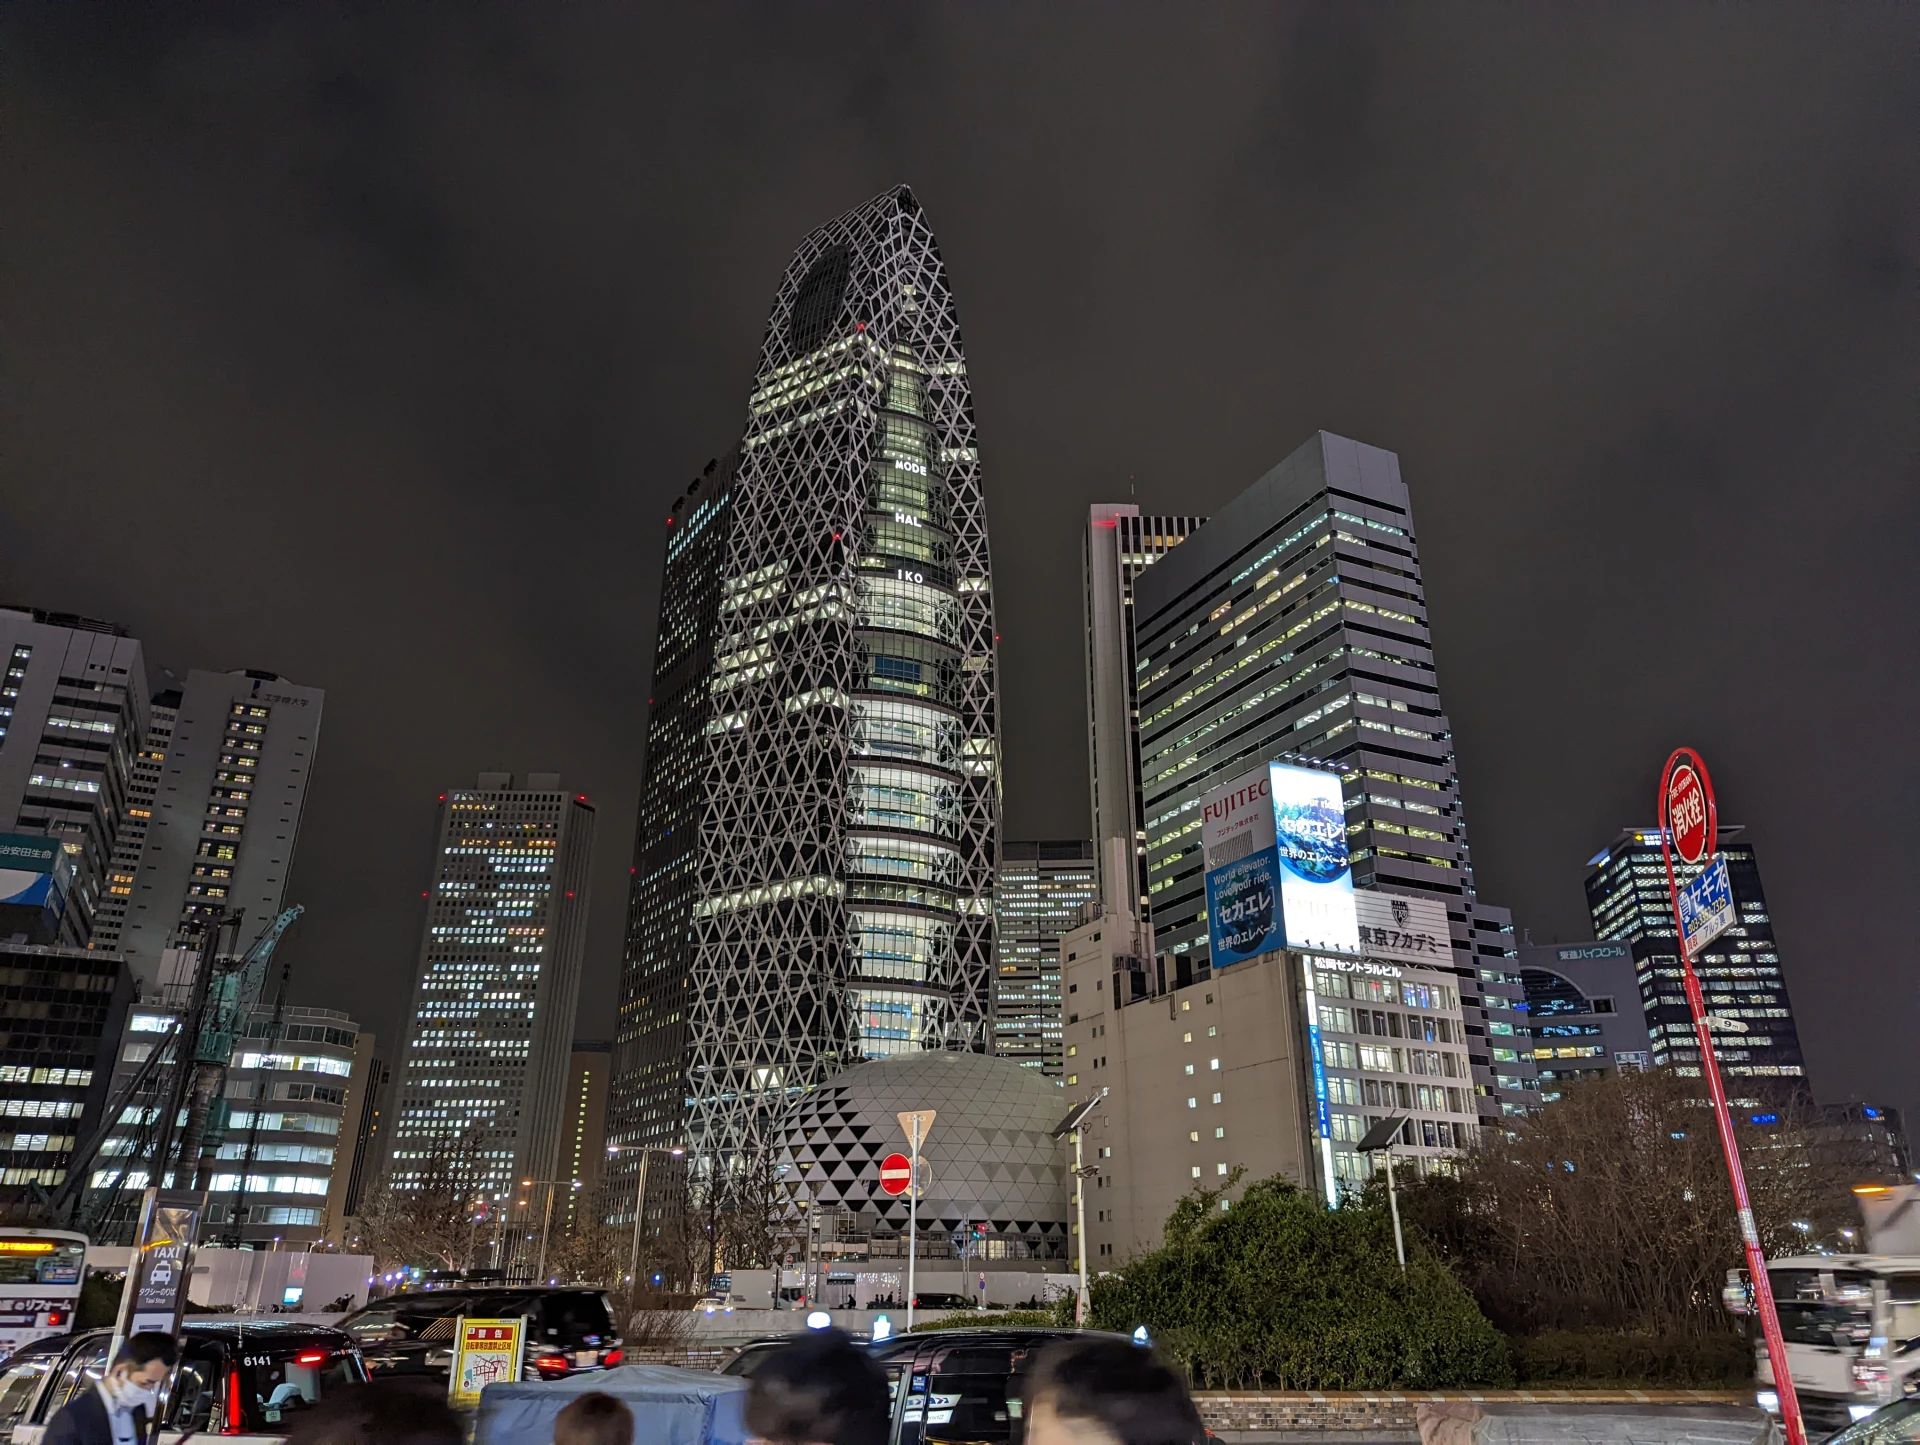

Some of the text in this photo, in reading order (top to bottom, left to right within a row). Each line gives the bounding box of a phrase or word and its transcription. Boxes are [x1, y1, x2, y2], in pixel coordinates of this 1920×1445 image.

[895, 460, 927, 476] MODE
[895, 512, 922, 527] HAL
[1204, 779, 1270, 823] FUJITEC
[1672, 787, 1703, 842] 消火栓
[1217, 814, 1259, 838] フジテック株式会社
[1280, 846, 1348, 867] 世界のエレベータ
[1213, 868, 1237, 886] World
[1214, 887, 1232, 902] Love
[1232, 880, 1253, 896] your
[1218, 921, 1277, 951] 世界のエレベータ
[1358, 925, 1449, 954] 東京アカデミー
[1559, 947, 1626, 960] 東進ハイスクール
[1314, 956, 1402, 978] 松岡セントラルビル
[153, 1246, 181, 1259] TAXI
[139, 1288, 177, 1299] タクシーのりば
[244, 1356, 271, 1367] 6141
